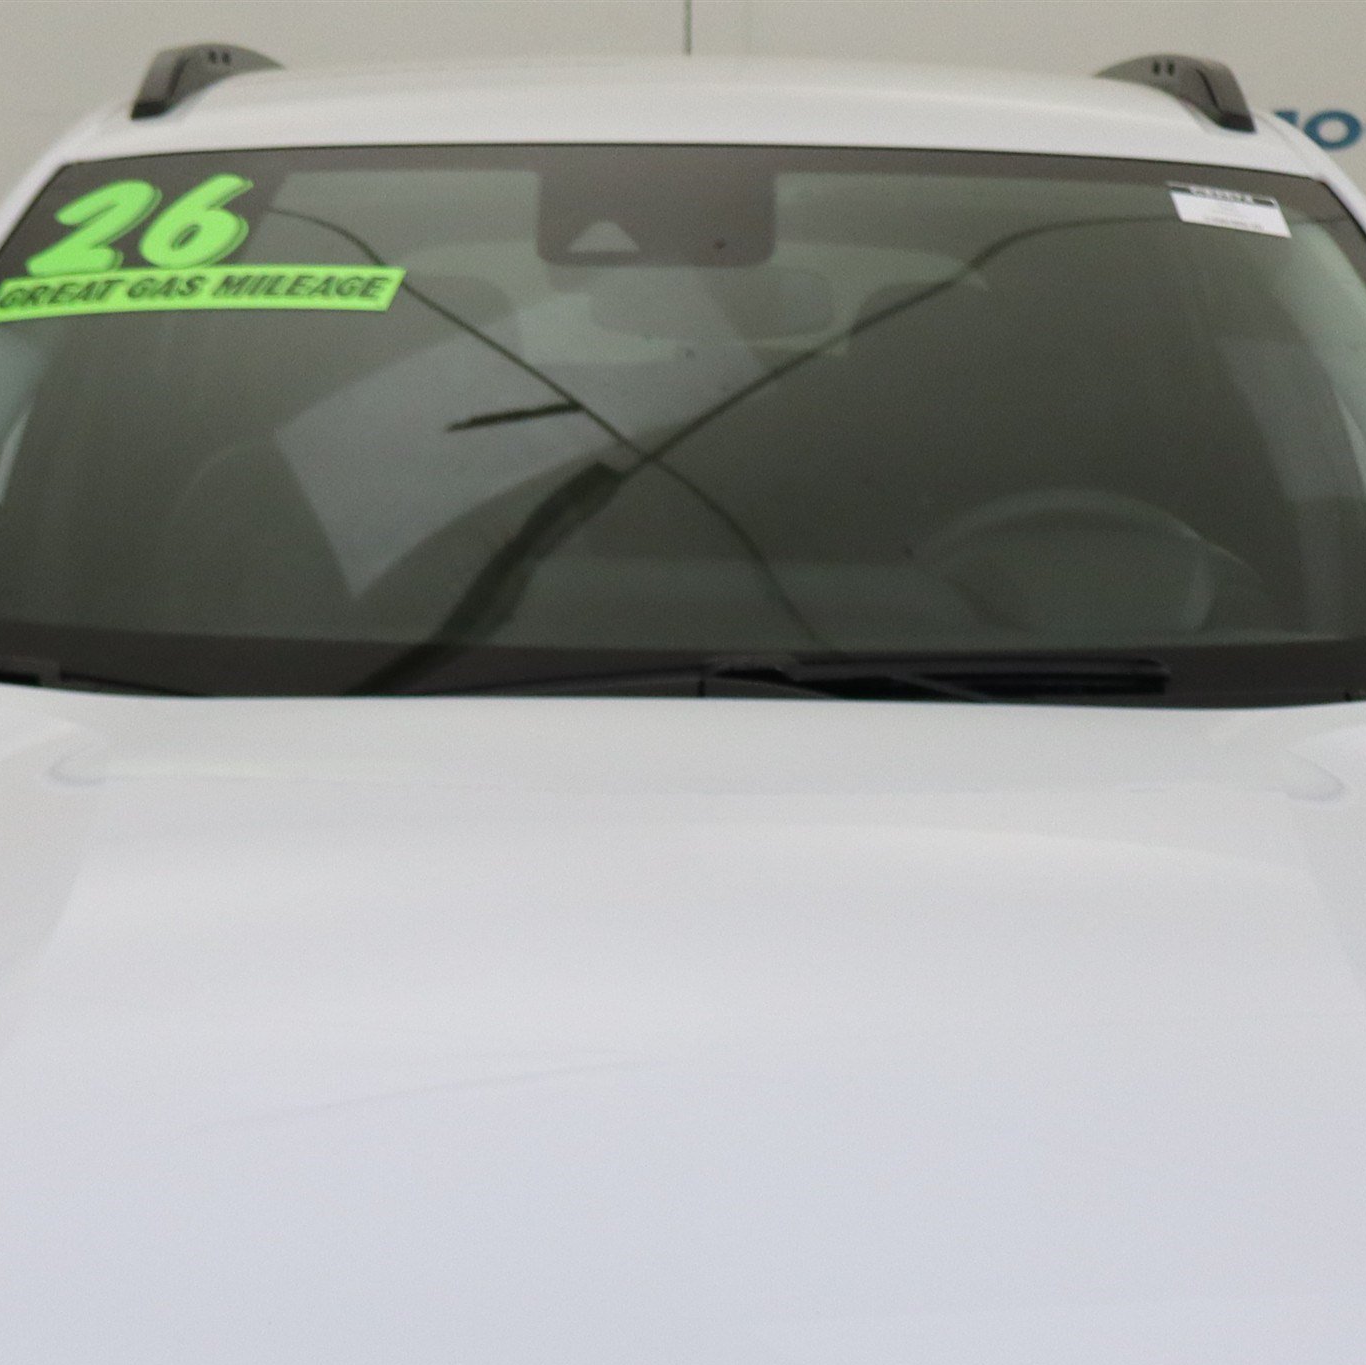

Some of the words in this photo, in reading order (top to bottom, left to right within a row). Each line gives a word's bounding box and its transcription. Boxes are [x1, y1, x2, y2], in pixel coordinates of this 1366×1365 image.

[25, 173, 254, 276] 26
[126, 274, 209, 301] GAS
[211, 274, 394, 301] MILEAGE
